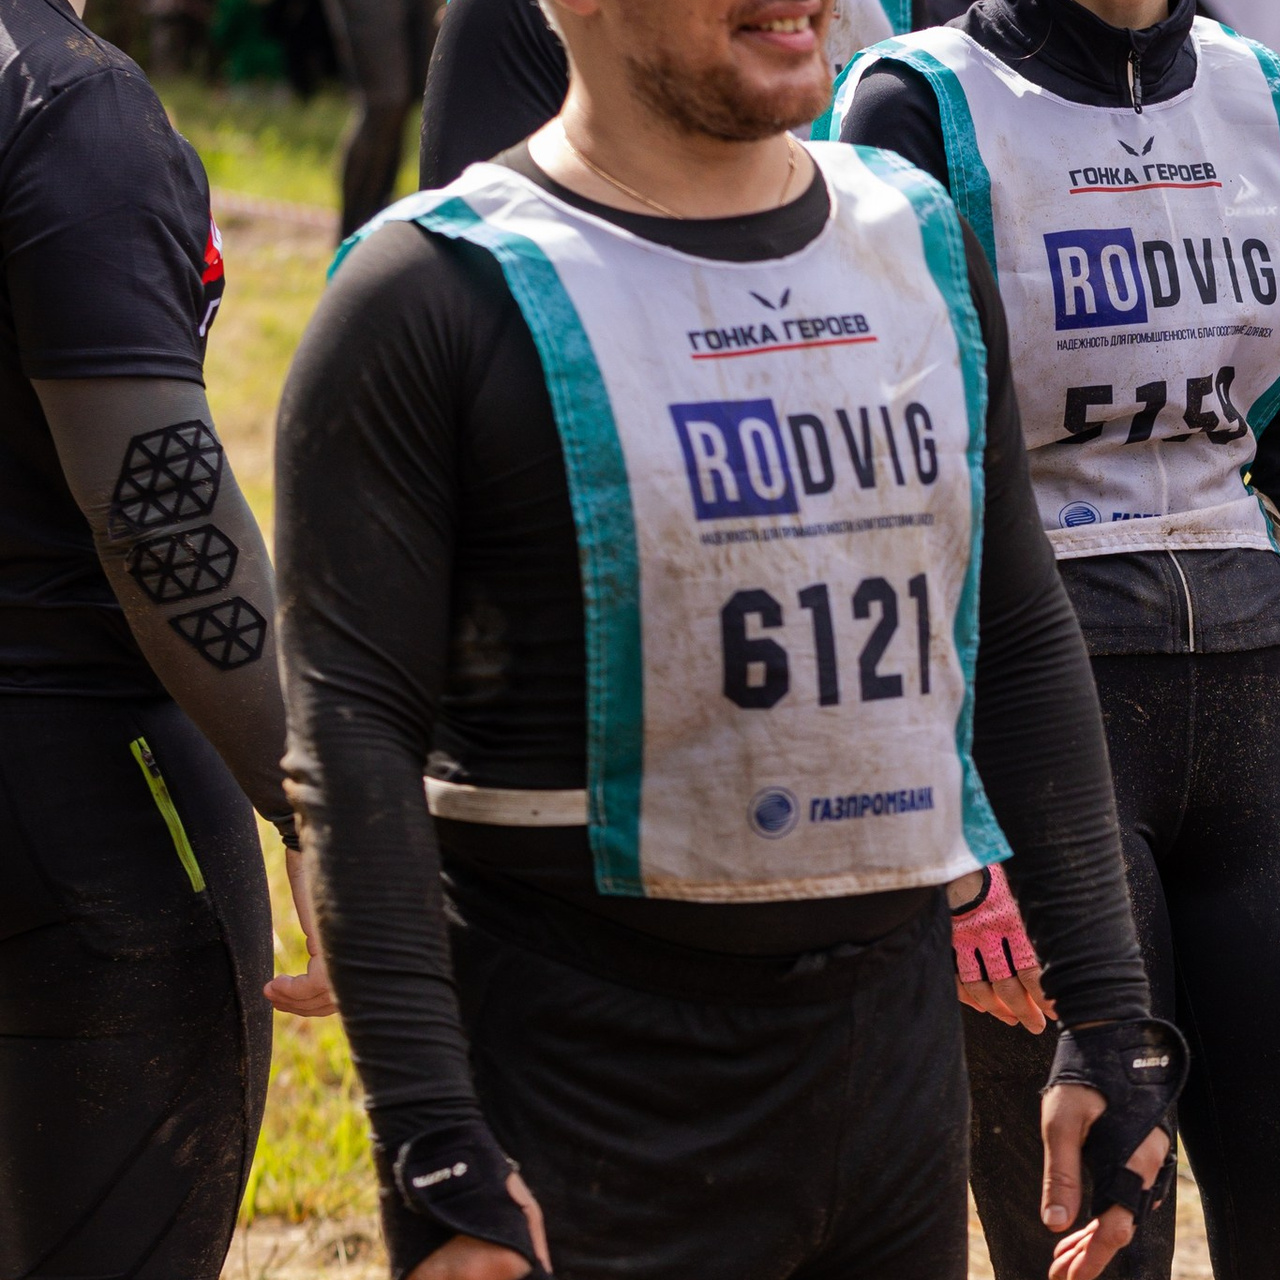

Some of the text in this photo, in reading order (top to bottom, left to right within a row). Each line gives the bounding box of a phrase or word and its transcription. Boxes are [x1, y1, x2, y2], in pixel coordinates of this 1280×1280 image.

[1069, 162, 1217, 187] ГОНКА ГЕРОЕВ
[1057, 237, 1277, 316] RODVIG
[688, 315, 870, 352] ГОНКА ГЕРОЕВ
[1056, 336, 1109, 351] НАДЕЖНОСТЬ
[1110, 334, 1127, 347] ДЛЯ
[685, 402, 938, 503] RODVIG
[720, 573, 930, 710] 6121
[809, 787, 934, 823] ГАЗПРОМБАНК
